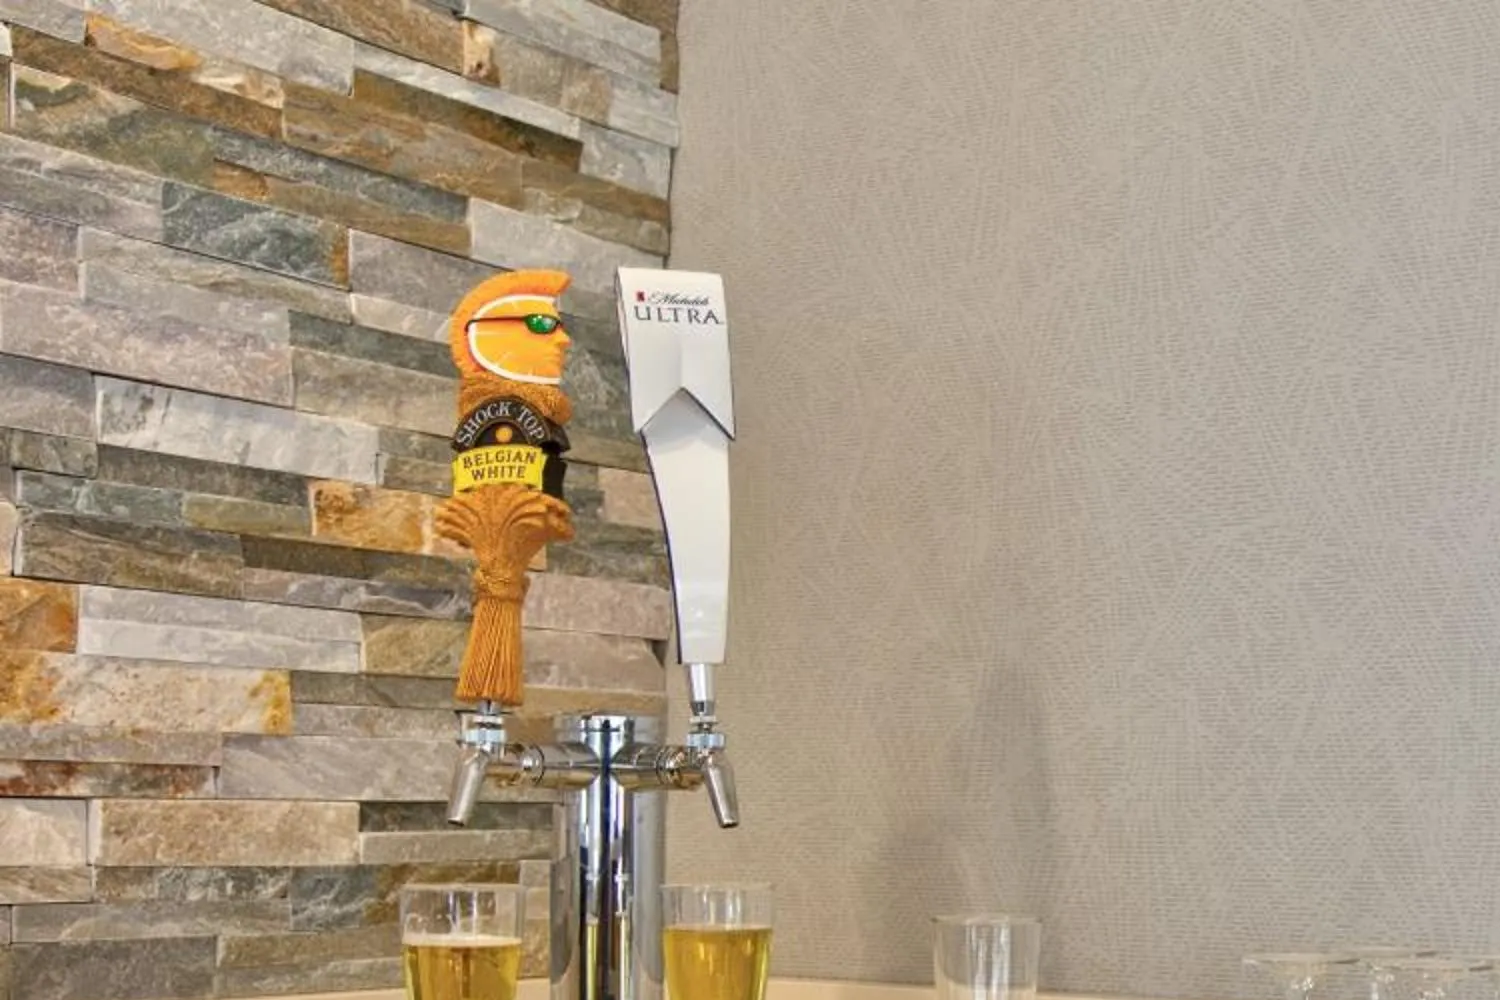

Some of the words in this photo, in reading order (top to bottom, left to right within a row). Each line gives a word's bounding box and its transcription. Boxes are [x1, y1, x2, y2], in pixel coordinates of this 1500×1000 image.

[634, 305, 722, 324] ULTRA
[456, 401, 512, 446] SHOCK
[517, 406, 545, 439] TOP
[463, 449, 537, 469] BELGIAN
[471, 465, 526, 480] WHITE
